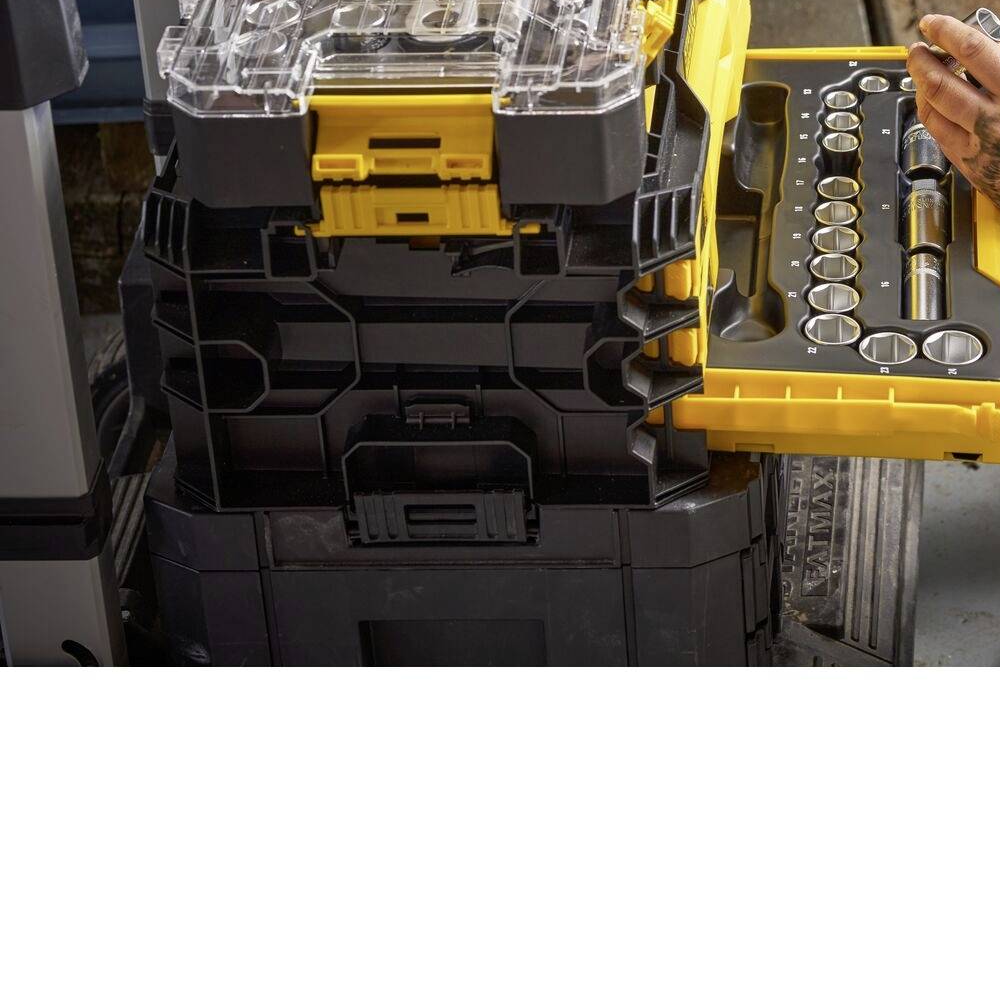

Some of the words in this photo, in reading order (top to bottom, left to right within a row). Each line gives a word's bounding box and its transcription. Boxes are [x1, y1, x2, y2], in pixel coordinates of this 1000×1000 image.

[807, 346, 817, 354] 22
[879, 366, 890, 374] 23
[804, 469, 835, 585] FATMAX
